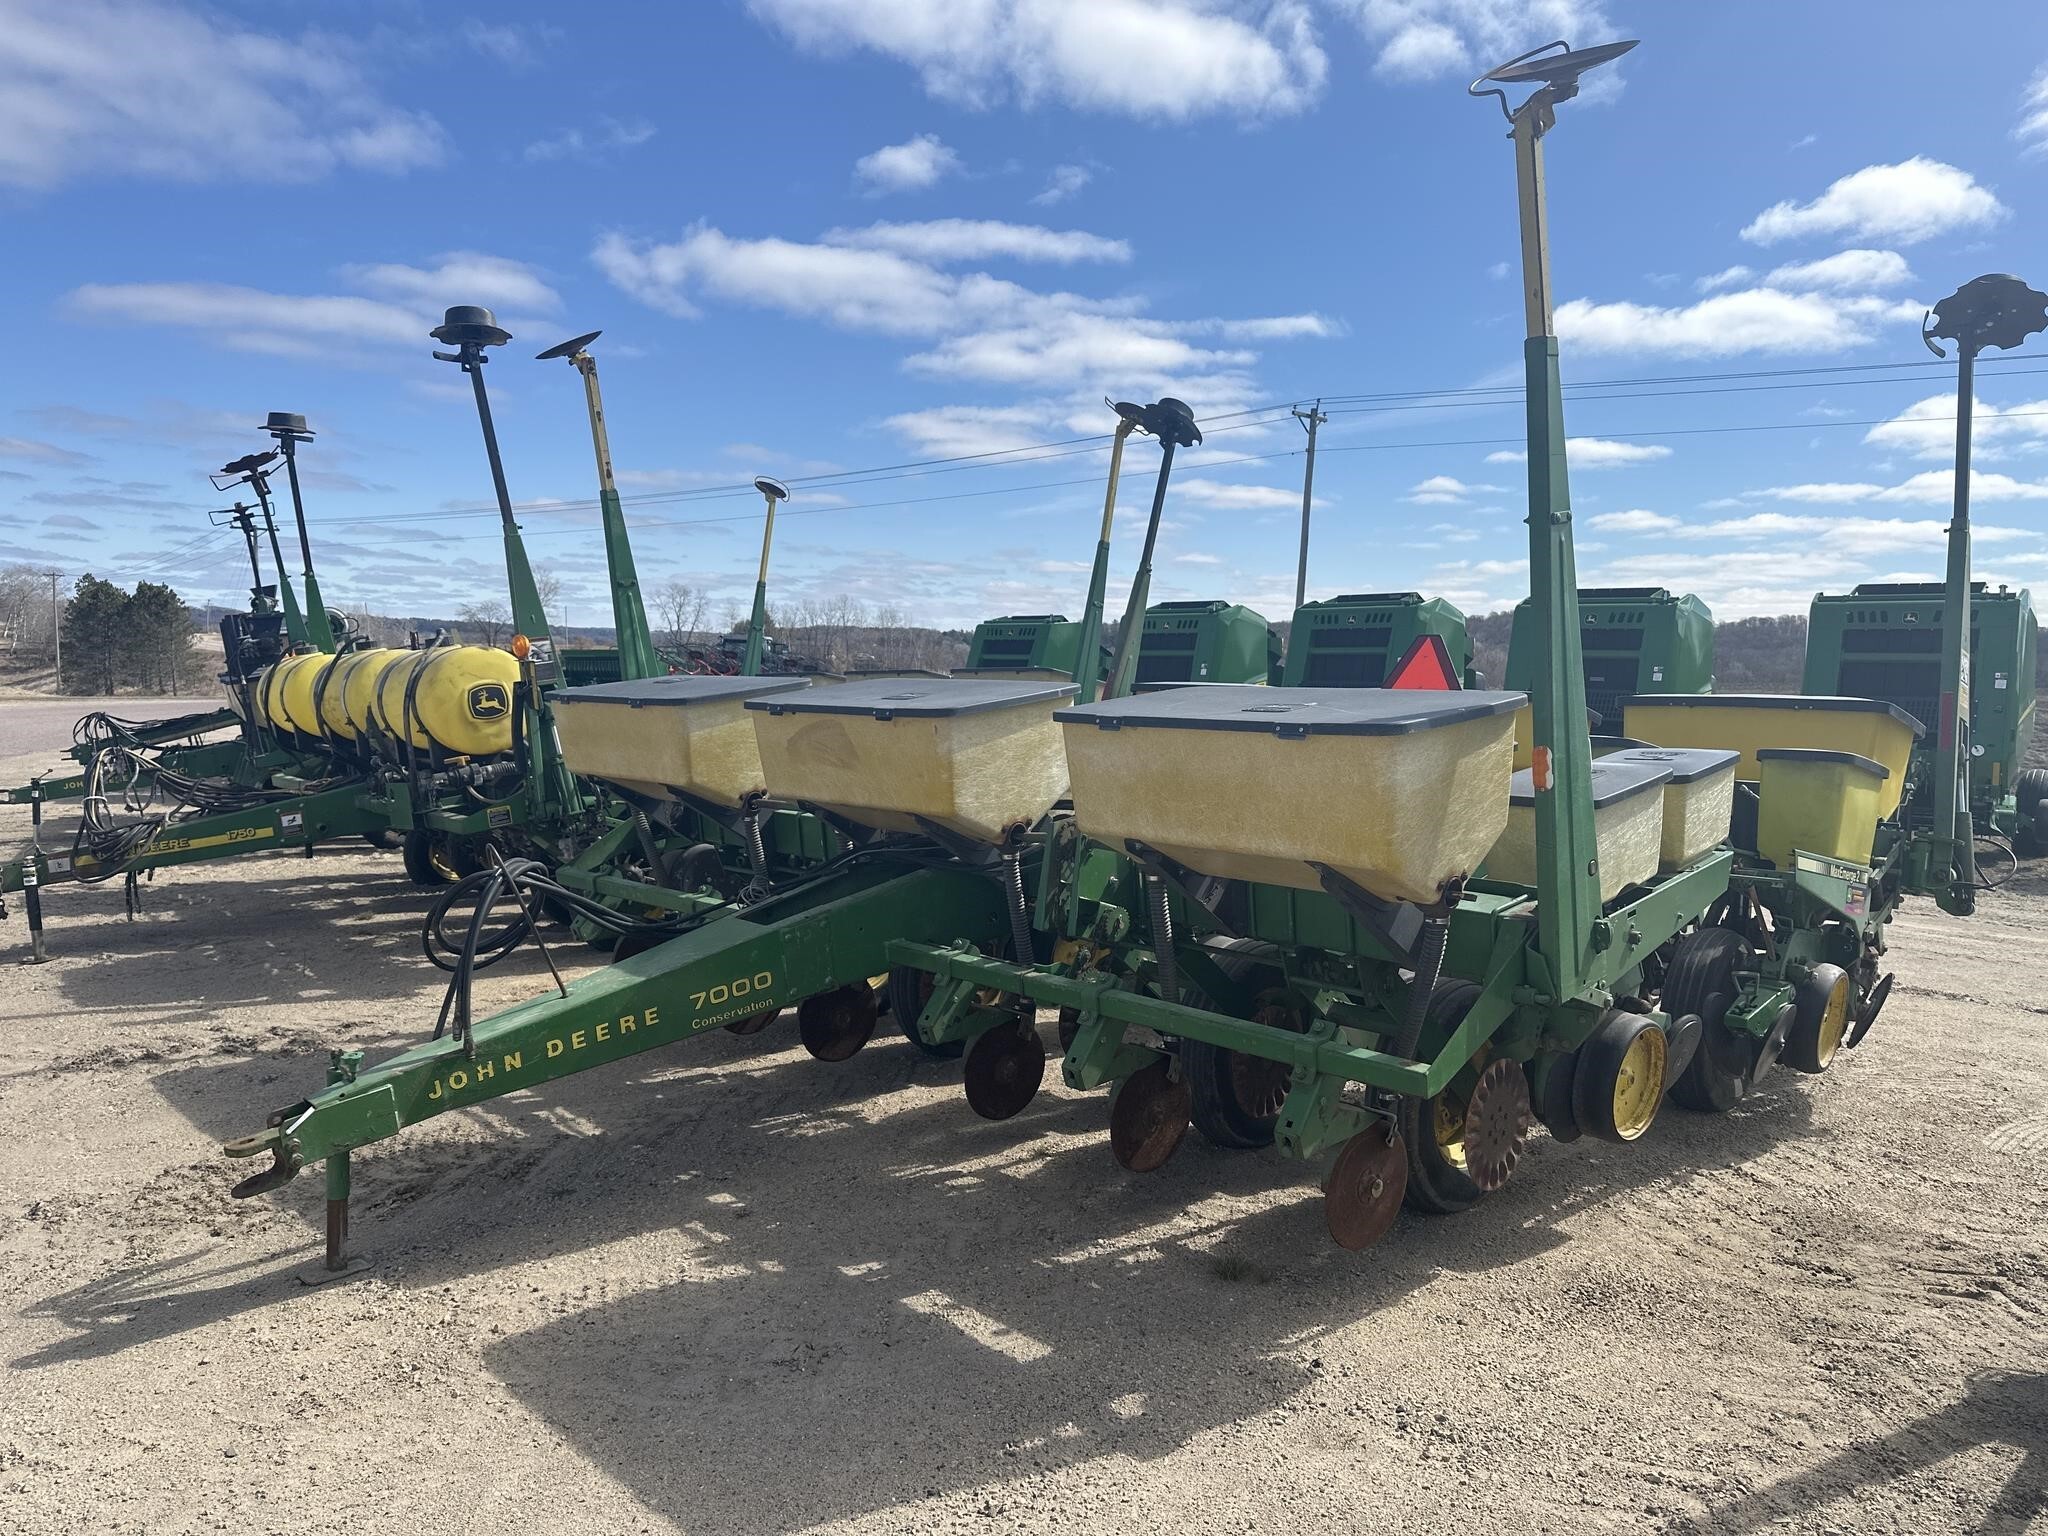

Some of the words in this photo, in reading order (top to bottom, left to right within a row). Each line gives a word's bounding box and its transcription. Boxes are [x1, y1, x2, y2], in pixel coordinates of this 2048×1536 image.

[226, 827, 256, 841] 1750
[691, 998, 774, 1030] Conservation
[428, 1051, 523, 1100] JOHN
[545, 1006, 661, 1059] DEERE
[689, 971, 773, 1011] 7000
